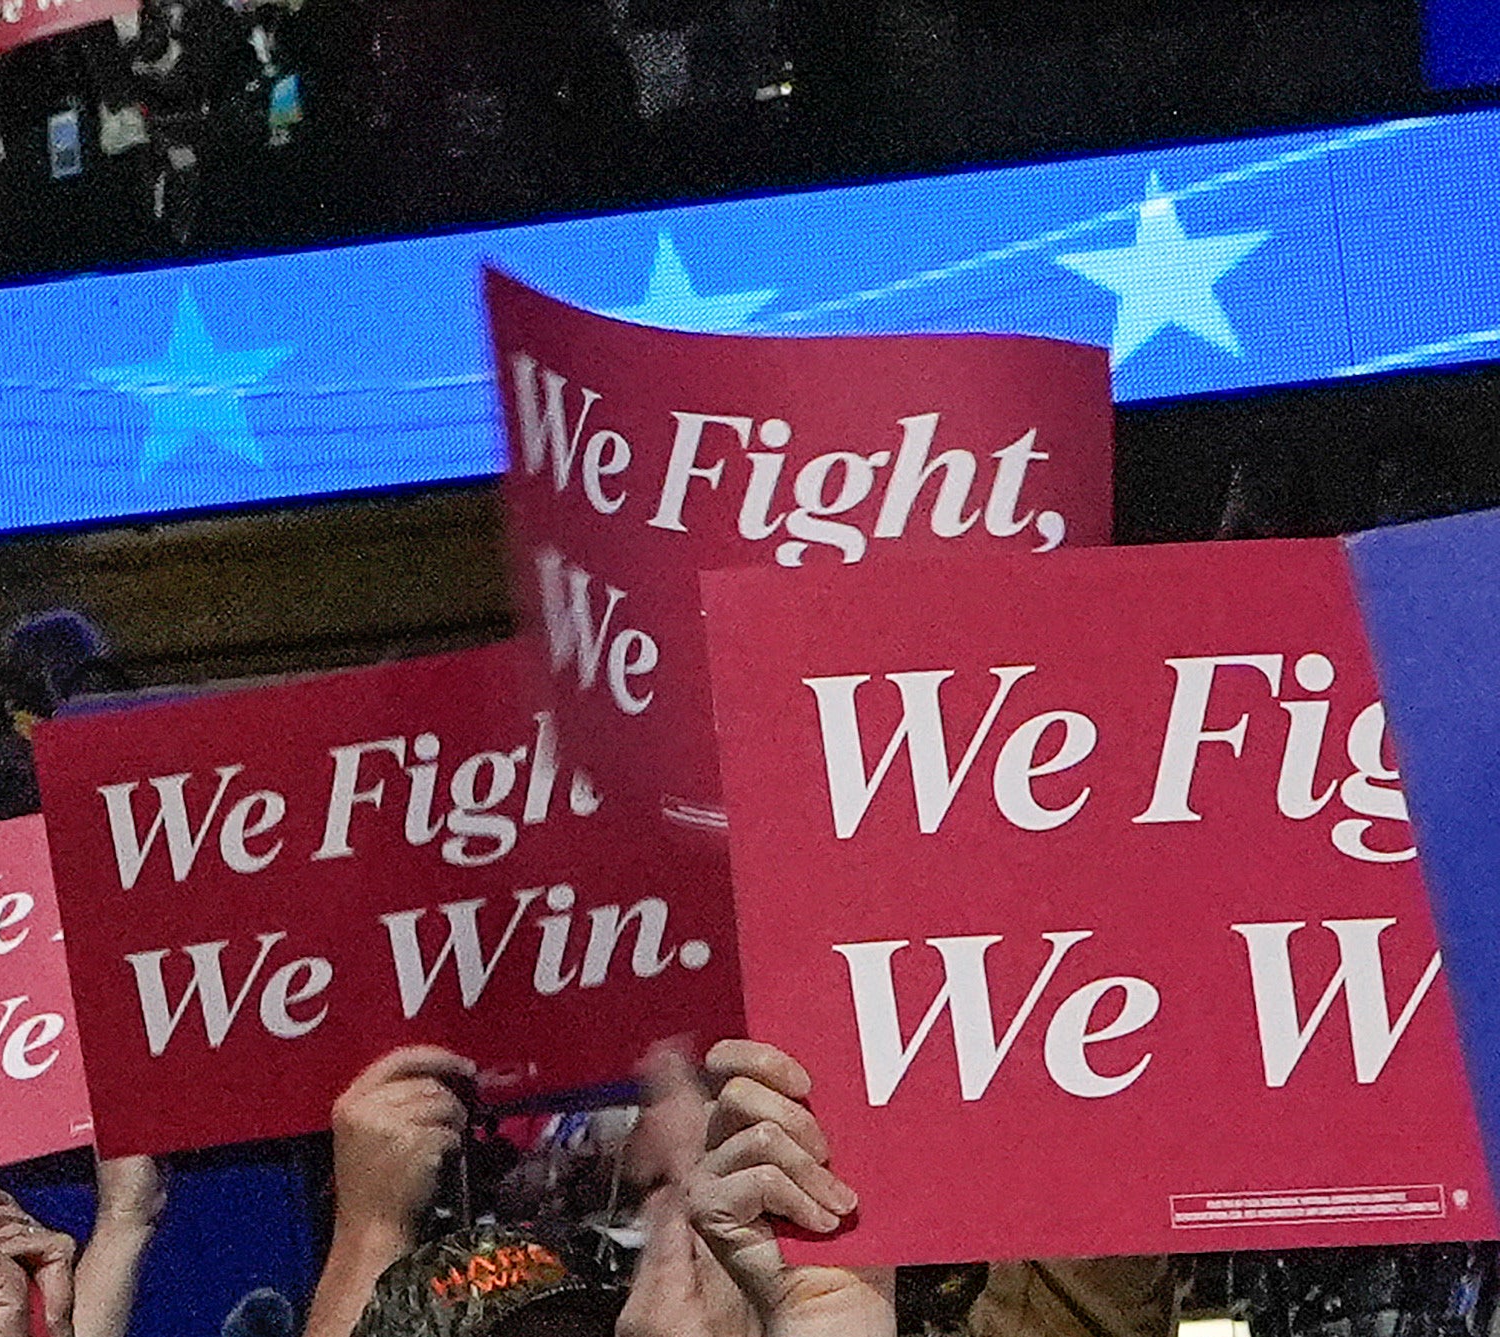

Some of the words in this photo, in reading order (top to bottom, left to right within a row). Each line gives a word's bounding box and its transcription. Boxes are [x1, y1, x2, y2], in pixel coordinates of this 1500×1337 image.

[513, 352, 632, 514] We
[646, 411, 1067, 567] Fight,
[534, 545, 660, 717] We
[99, 764, 286, 890] We
[802, 664, 1099, 840] We
[1131, 653, 1419, 863] Fig
[124, 931, 335, 1057] We
[380, 882, 712, 1020] Win.
[831, 930, 1161, 1107] We
